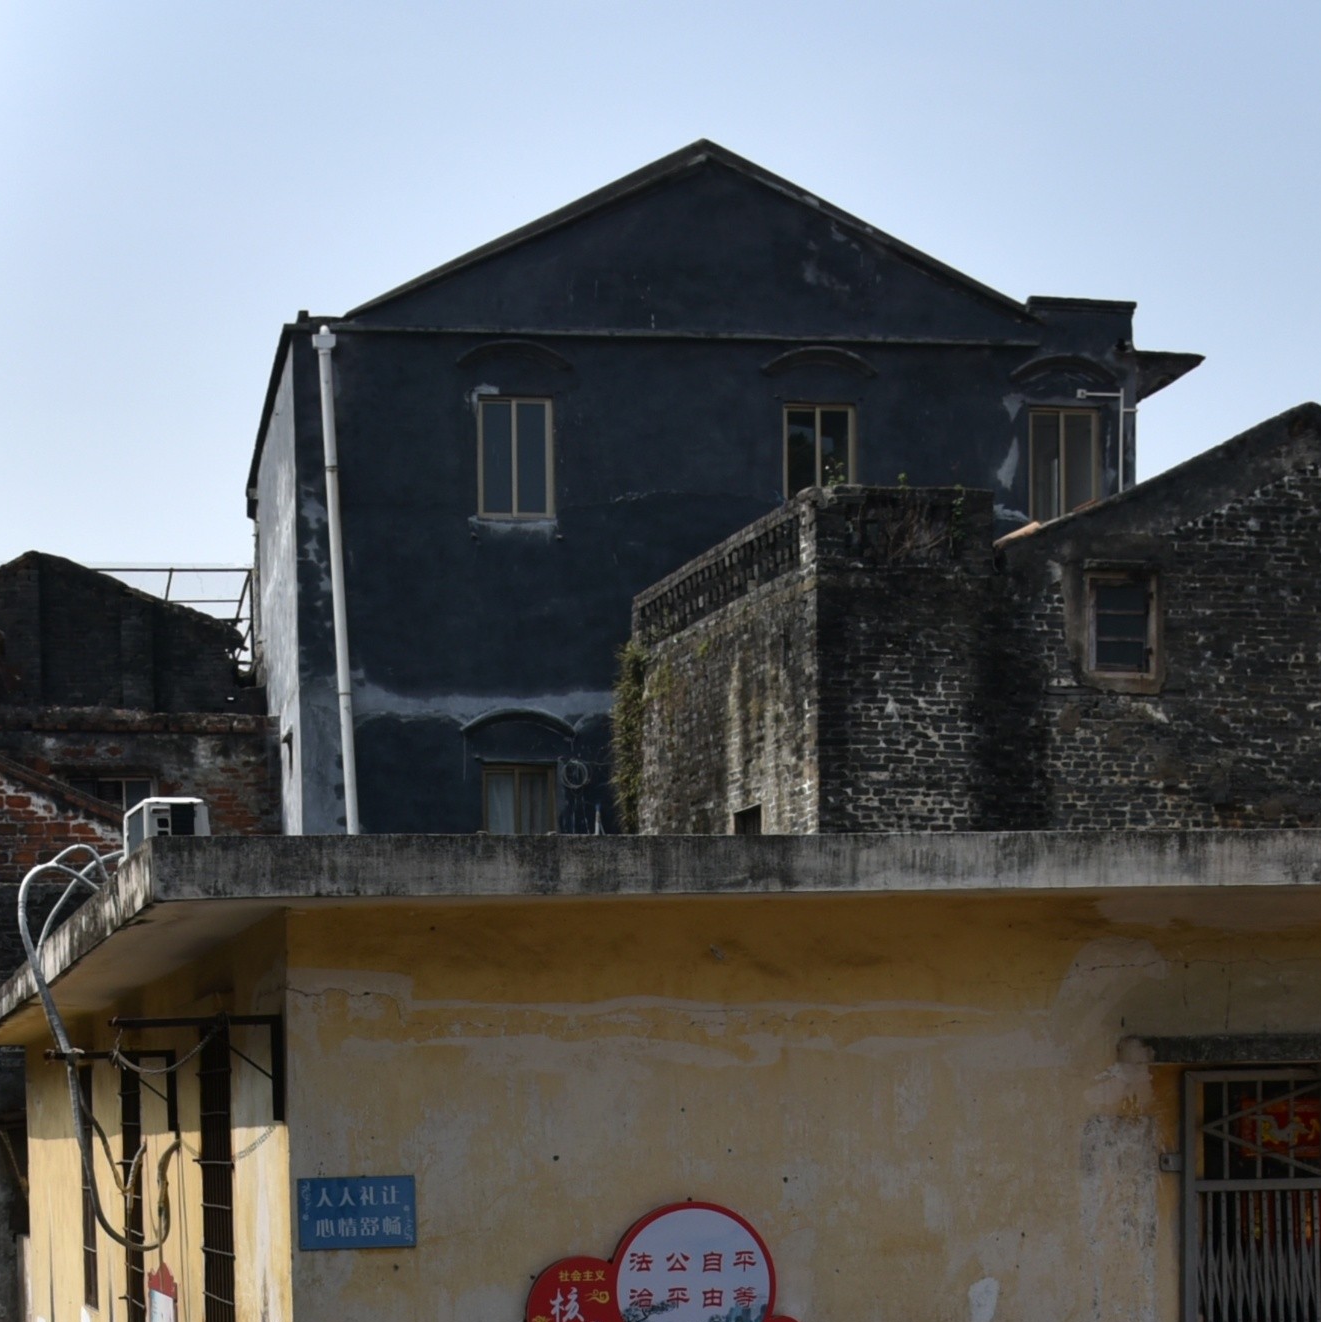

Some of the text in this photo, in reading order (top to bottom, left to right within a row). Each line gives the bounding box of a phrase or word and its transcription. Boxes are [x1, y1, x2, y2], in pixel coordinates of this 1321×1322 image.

[316, 1185, 400, 1208] 人人礼让
[315, 1216, 402, 1238] 心情舒畅
[558, 1269, 607, 1283] 社会主义
[629, 1251, 654, 1309] 法治
[665, 1251, 691, 1309] 公平
[702, 1250, 724, 1309] 自由
[733, 1250, 758, 1308] 平等
